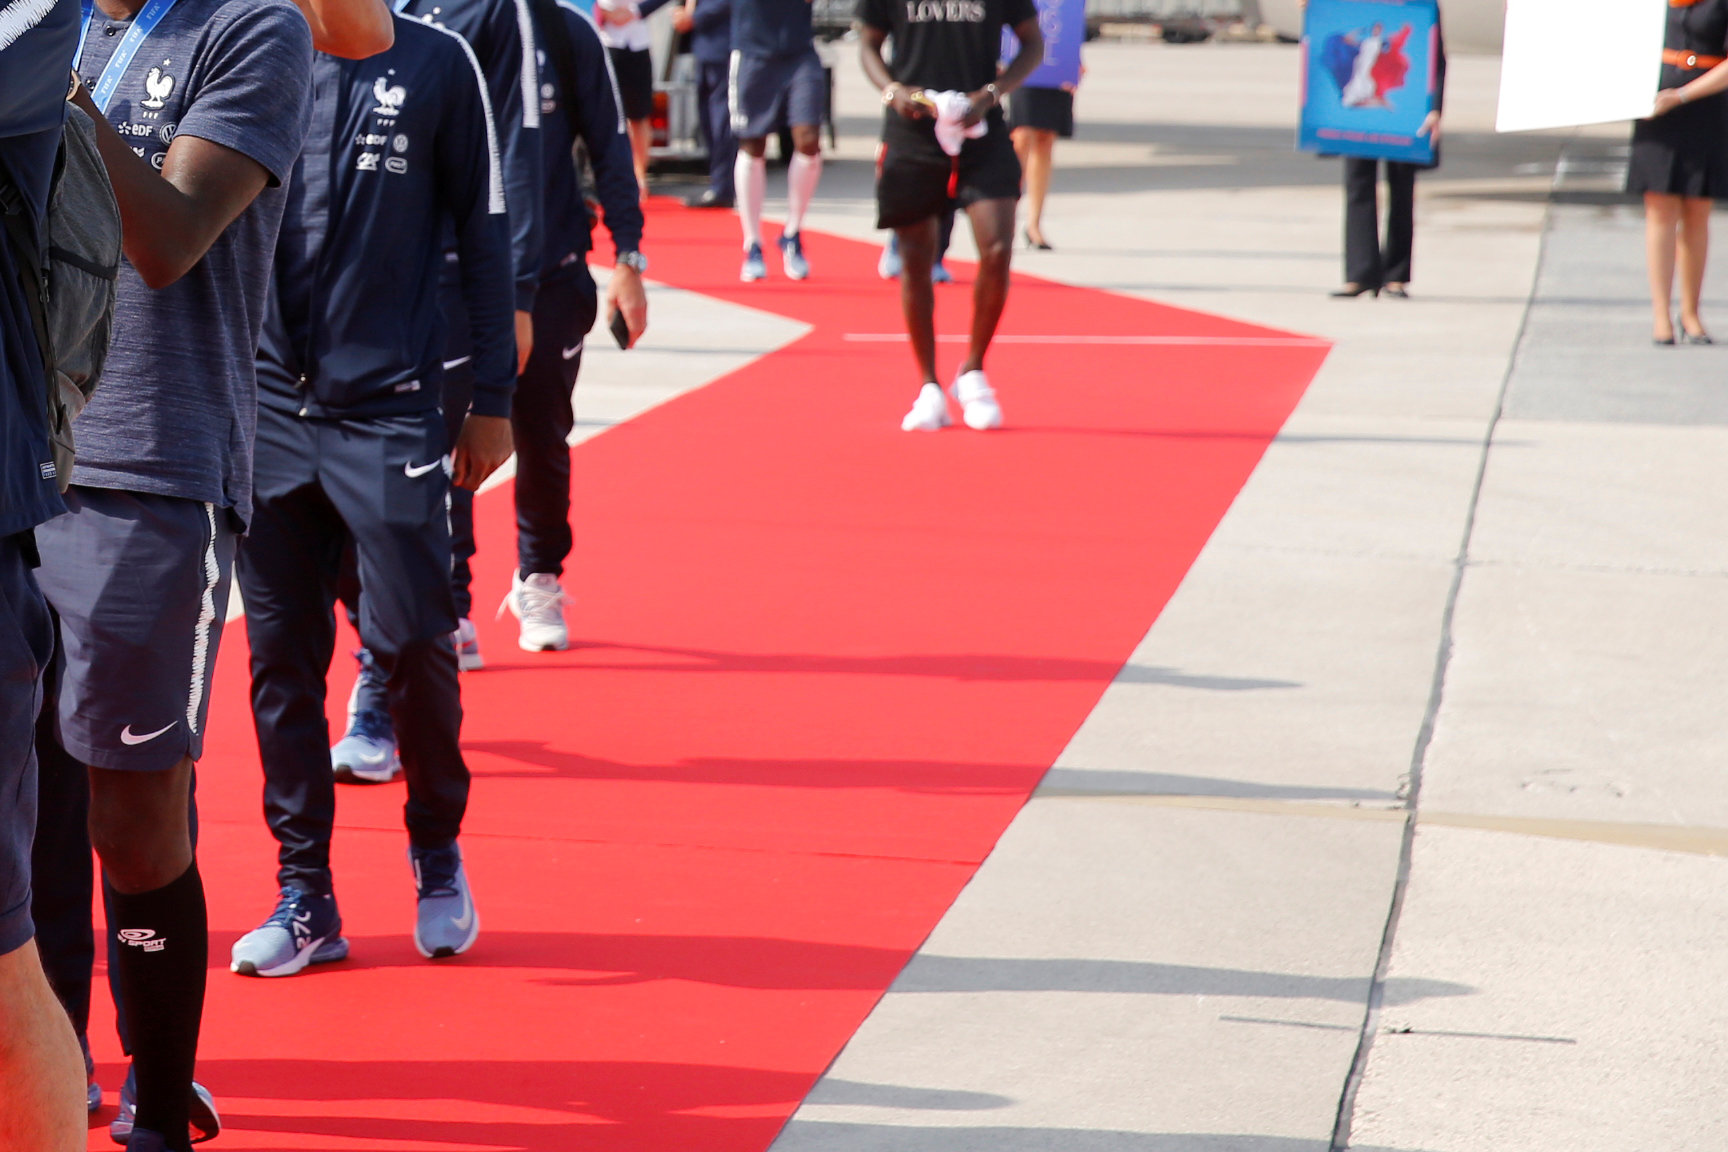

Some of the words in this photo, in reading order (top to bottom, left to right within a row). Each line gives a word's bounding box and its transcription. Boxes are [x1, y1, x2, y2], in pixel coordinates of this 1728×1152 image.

[146, 2, 160, 20] FIFA
[907, 0, 986, 22] LOVERS
[129, 24, 143, 43] FIFA
[115, 50, 128, 68] FIFA
[100, 75, 112, 94] FIFA
